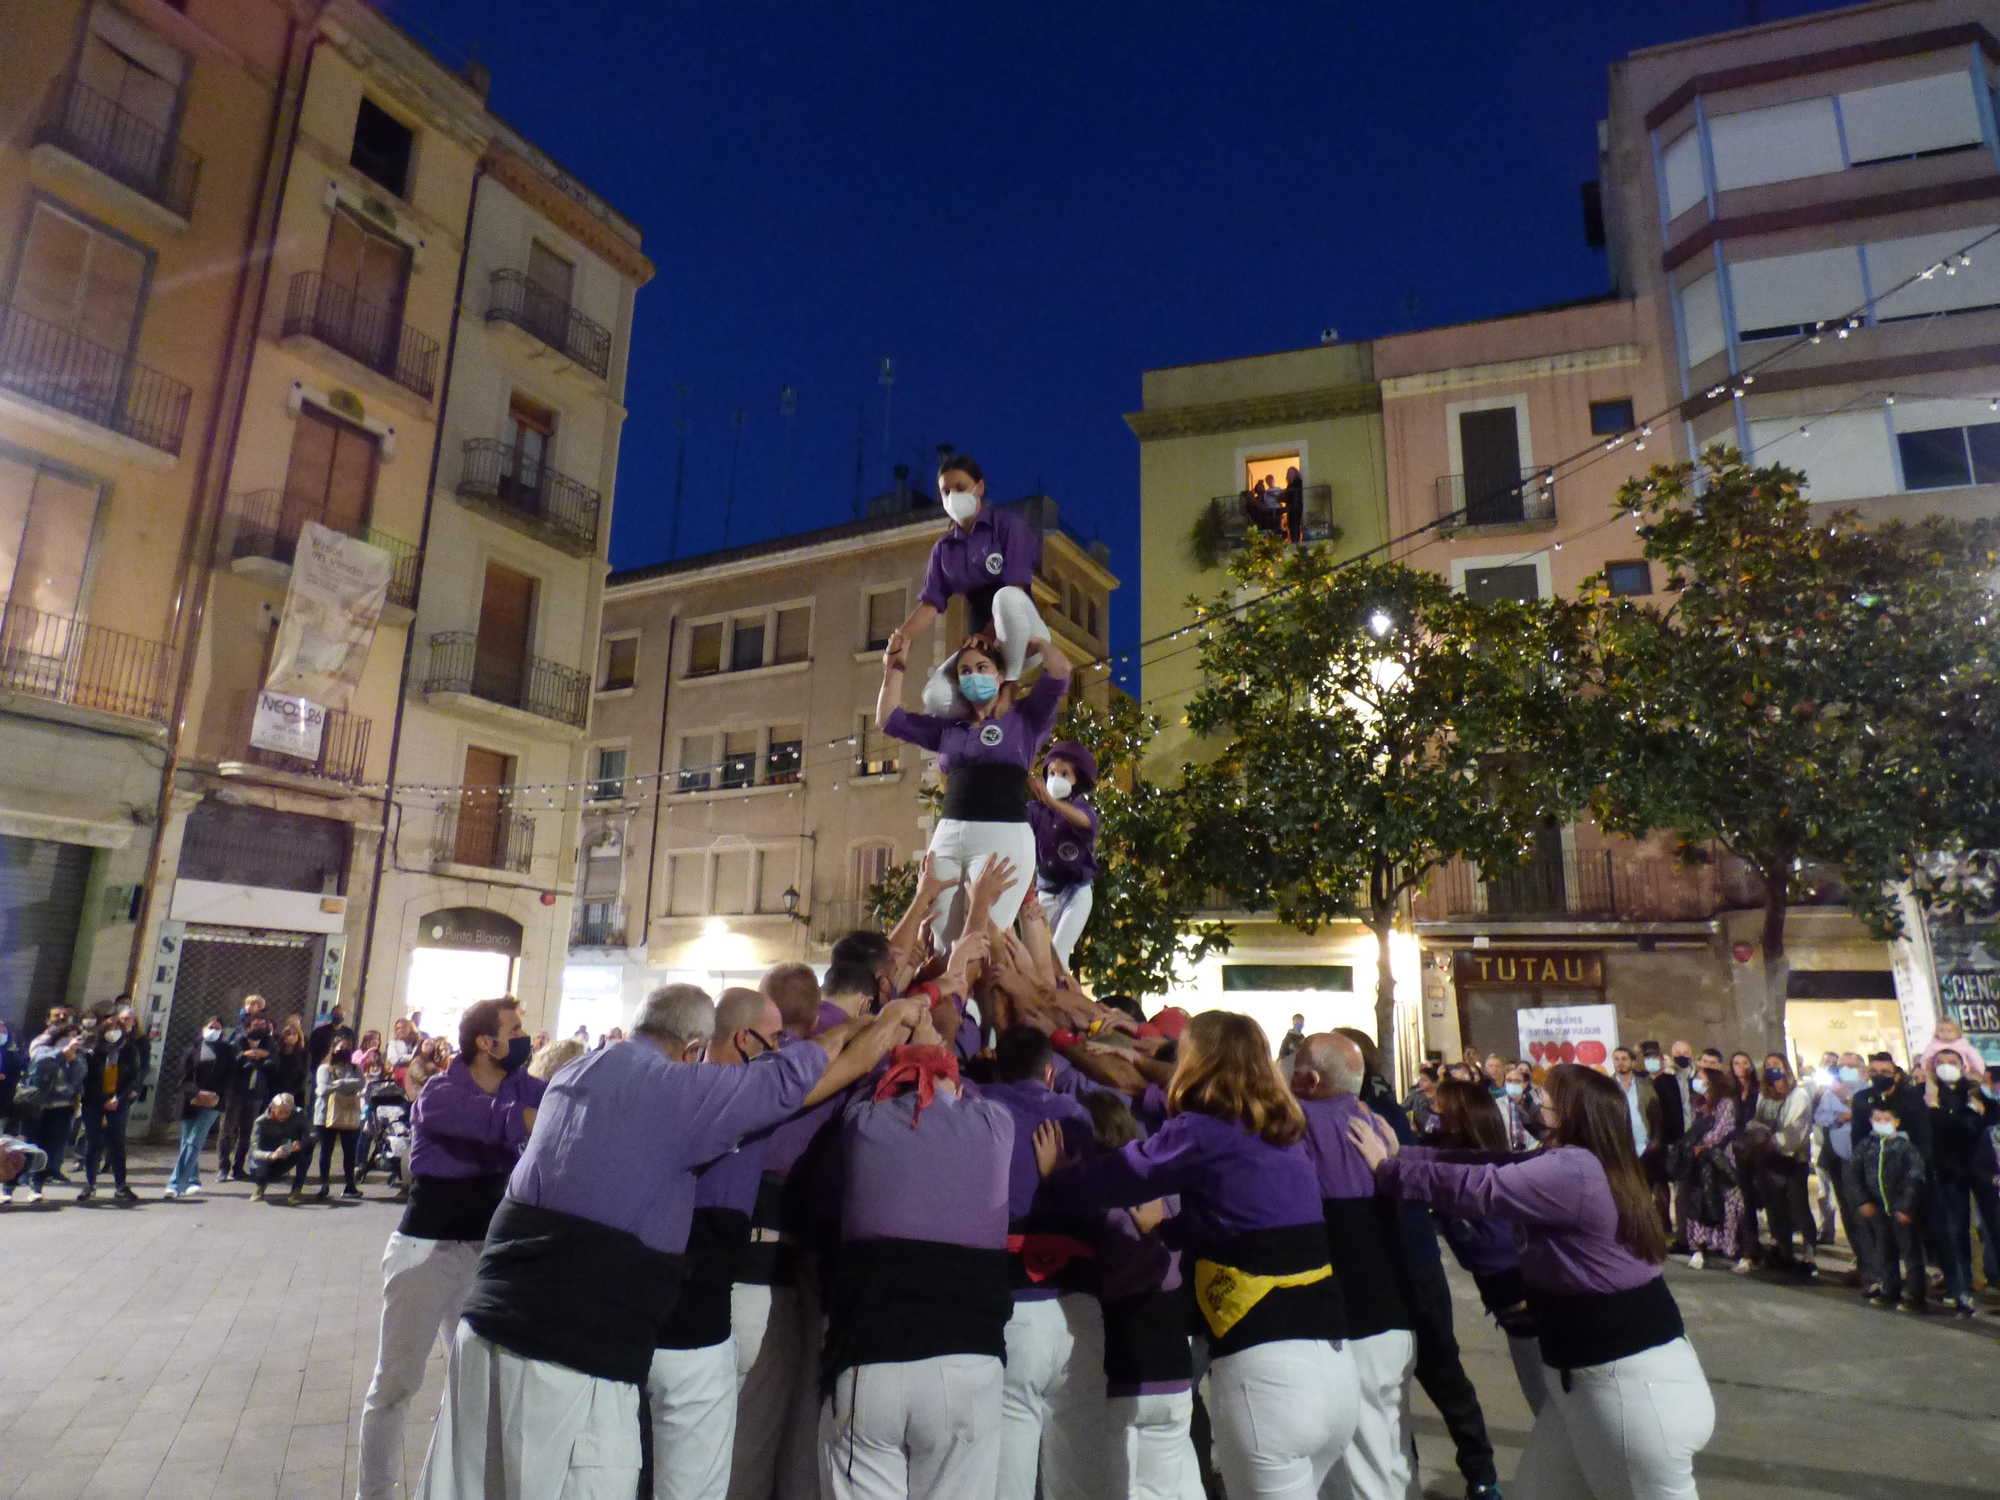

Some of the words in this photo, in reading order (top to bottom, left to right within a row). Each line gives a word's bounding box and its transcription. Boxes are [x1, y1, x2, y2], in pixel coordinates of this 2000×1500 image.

[444, 926, 473, 943] Punto
[475, 929, 511, 946] Blanco
[1474, 957, 1584, 982] TUTAU
[1941, 974, 2000, 1001] SCIENC
[1946, 1003, 2000, 1031] NEEDS
